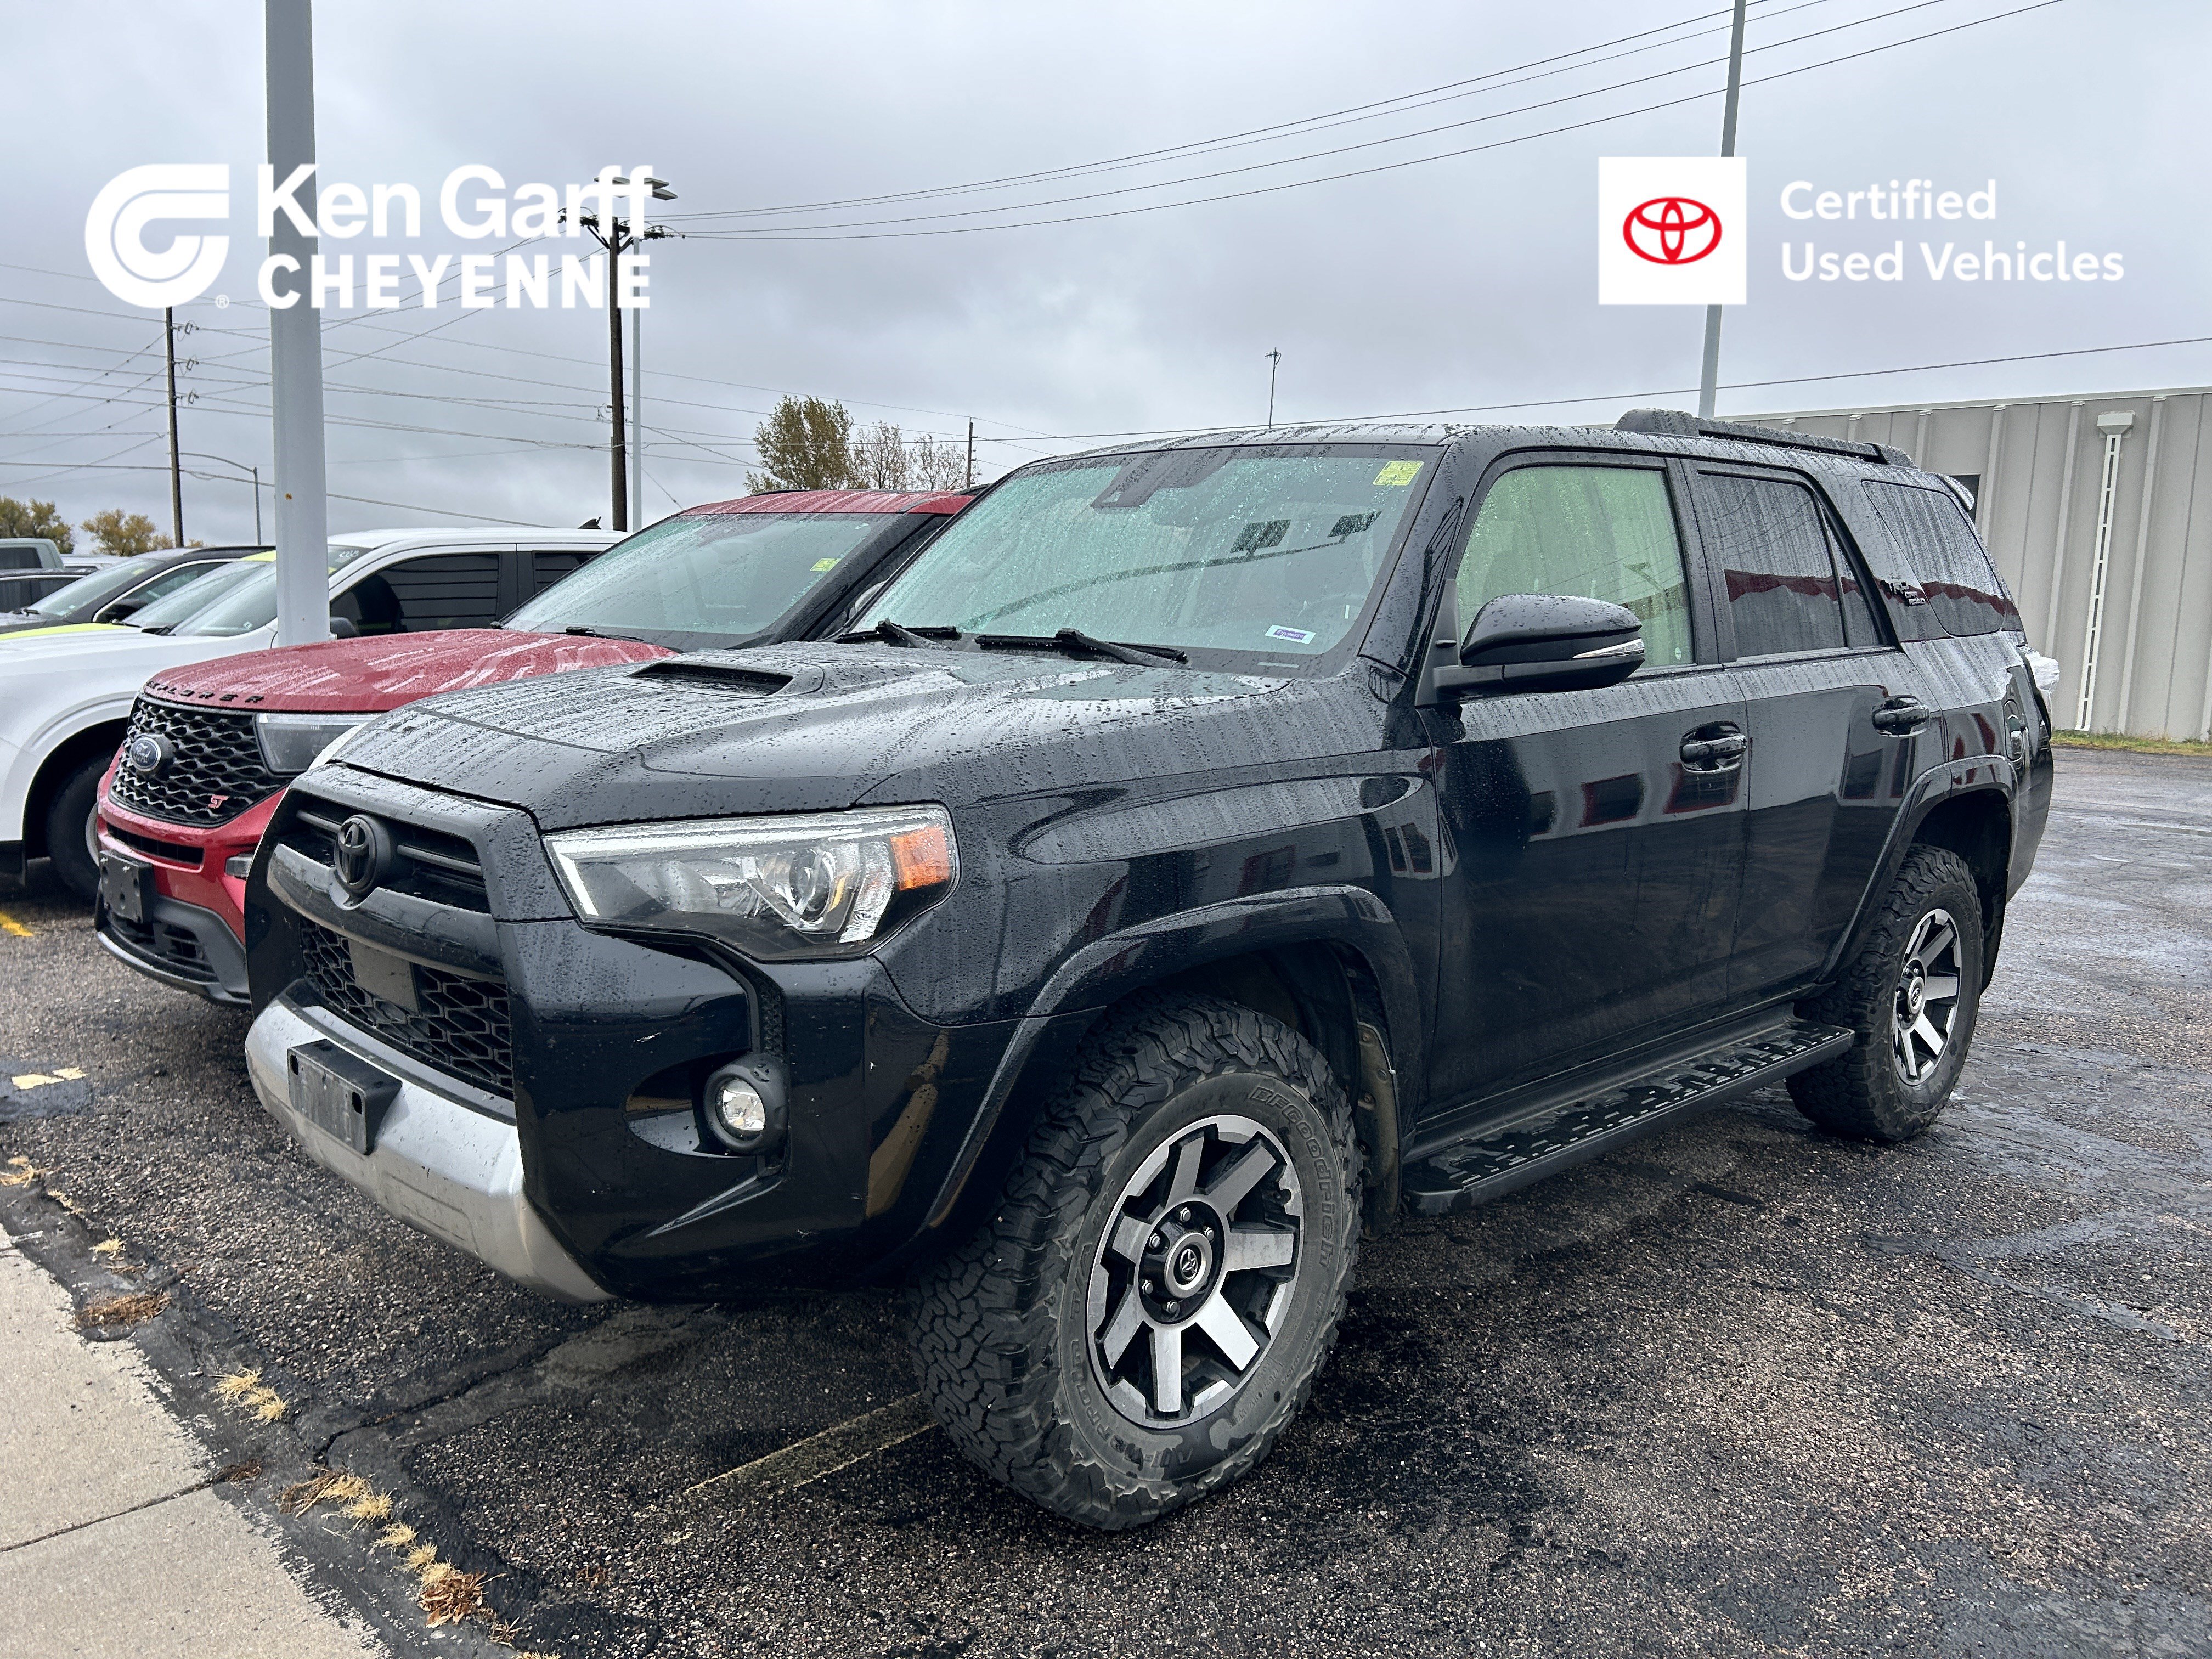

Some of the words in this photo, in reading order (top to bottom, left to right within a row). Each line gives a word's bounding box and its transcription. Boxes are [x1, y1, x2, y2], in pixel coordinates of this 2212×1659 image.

[146, 680, 265, 703] EXPLORER
[207, 794, 229, 809] ST
[1249, 1086, 1335, 1268] BFGoodrich
